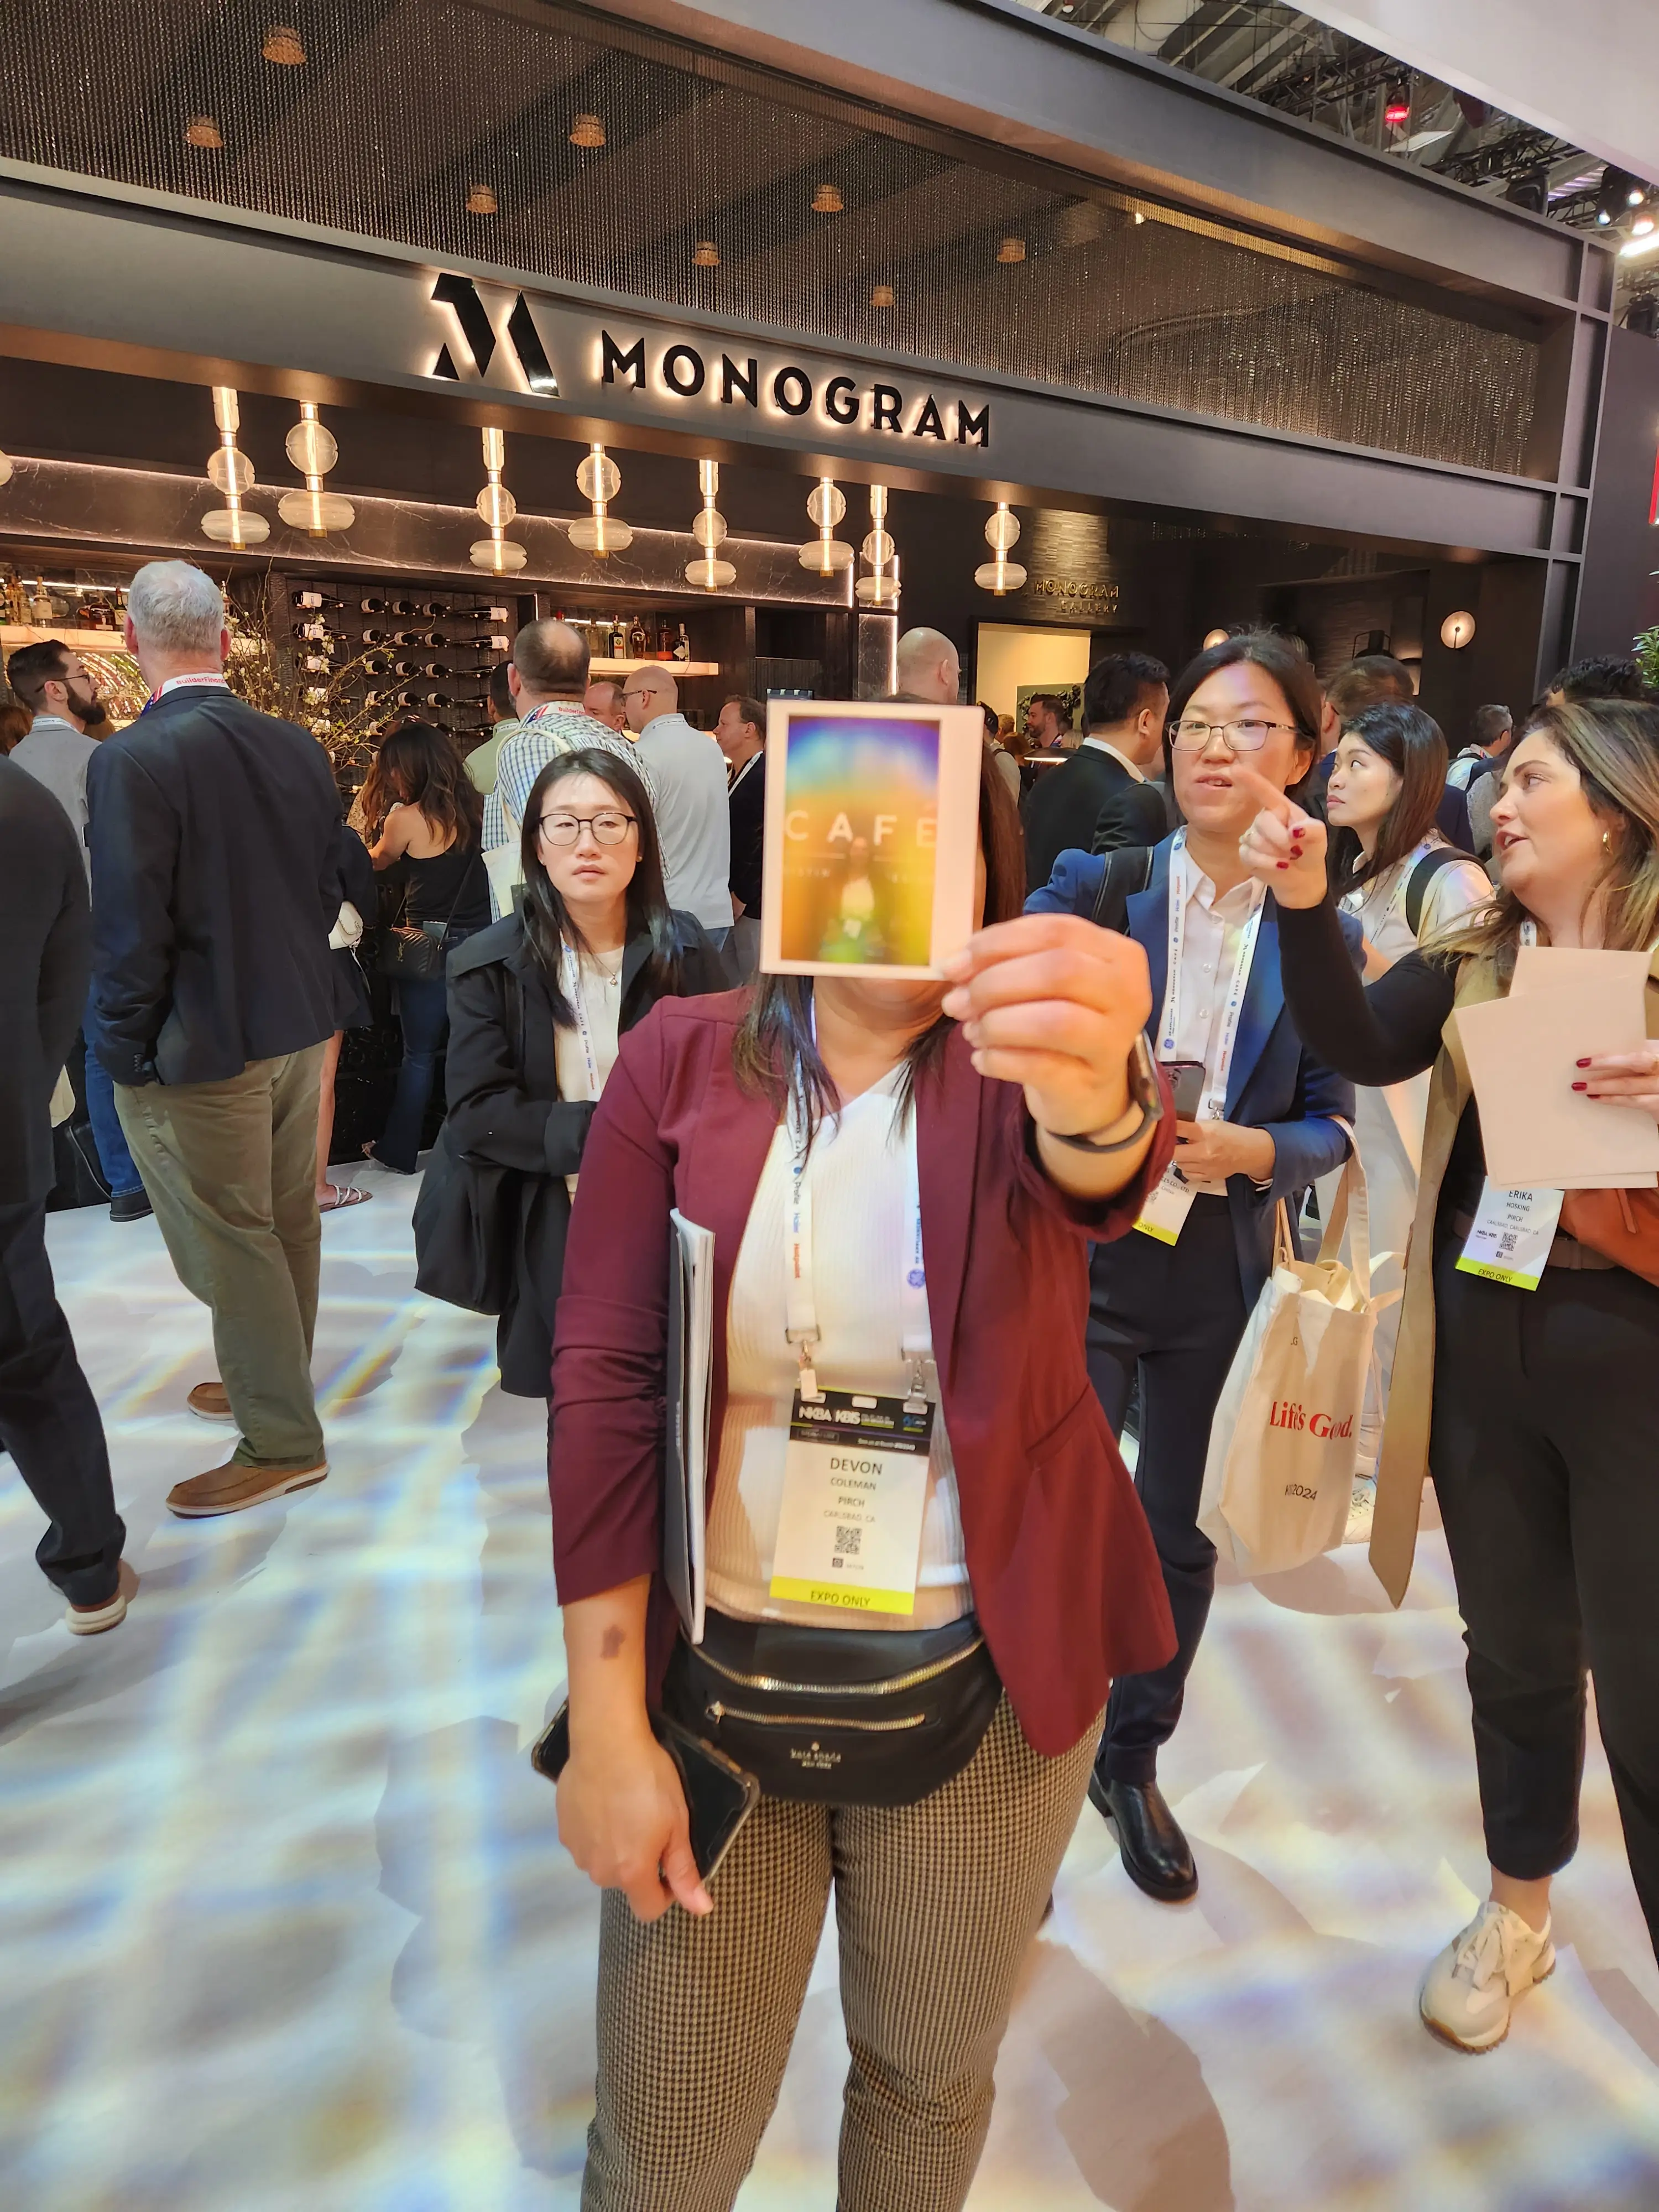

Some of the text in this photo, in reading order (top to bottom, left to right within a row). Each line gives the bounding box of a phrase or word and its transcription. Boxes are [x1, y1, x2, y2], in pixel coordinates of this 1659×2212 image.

[601, 330, 990, 447] MONOGRAM
[1035, 580, 1119, 598] MONOGRAM
[1061, 600, 1118, 613] GALLERY
[1509, 1190, 1533, 1202] ERIKA
[1506, 1202, 1530, 1212] HOSKING
[1507, 1214, 1524, 1223] PIRCH
[1138, 1222, 1155, 1233] ONLY
[1478, 1268, 1513, 1284] EXPO ONLY
[1270, 1401, 1307, 1431] Life's
[830, 1457, 883, 1476] DEVON
[830, 1477, 877, 1491] COLEMAN
[838, 1496, 865, 1509] PIRCH
[810, 1590, 871, 1608] EXPO ONLY
